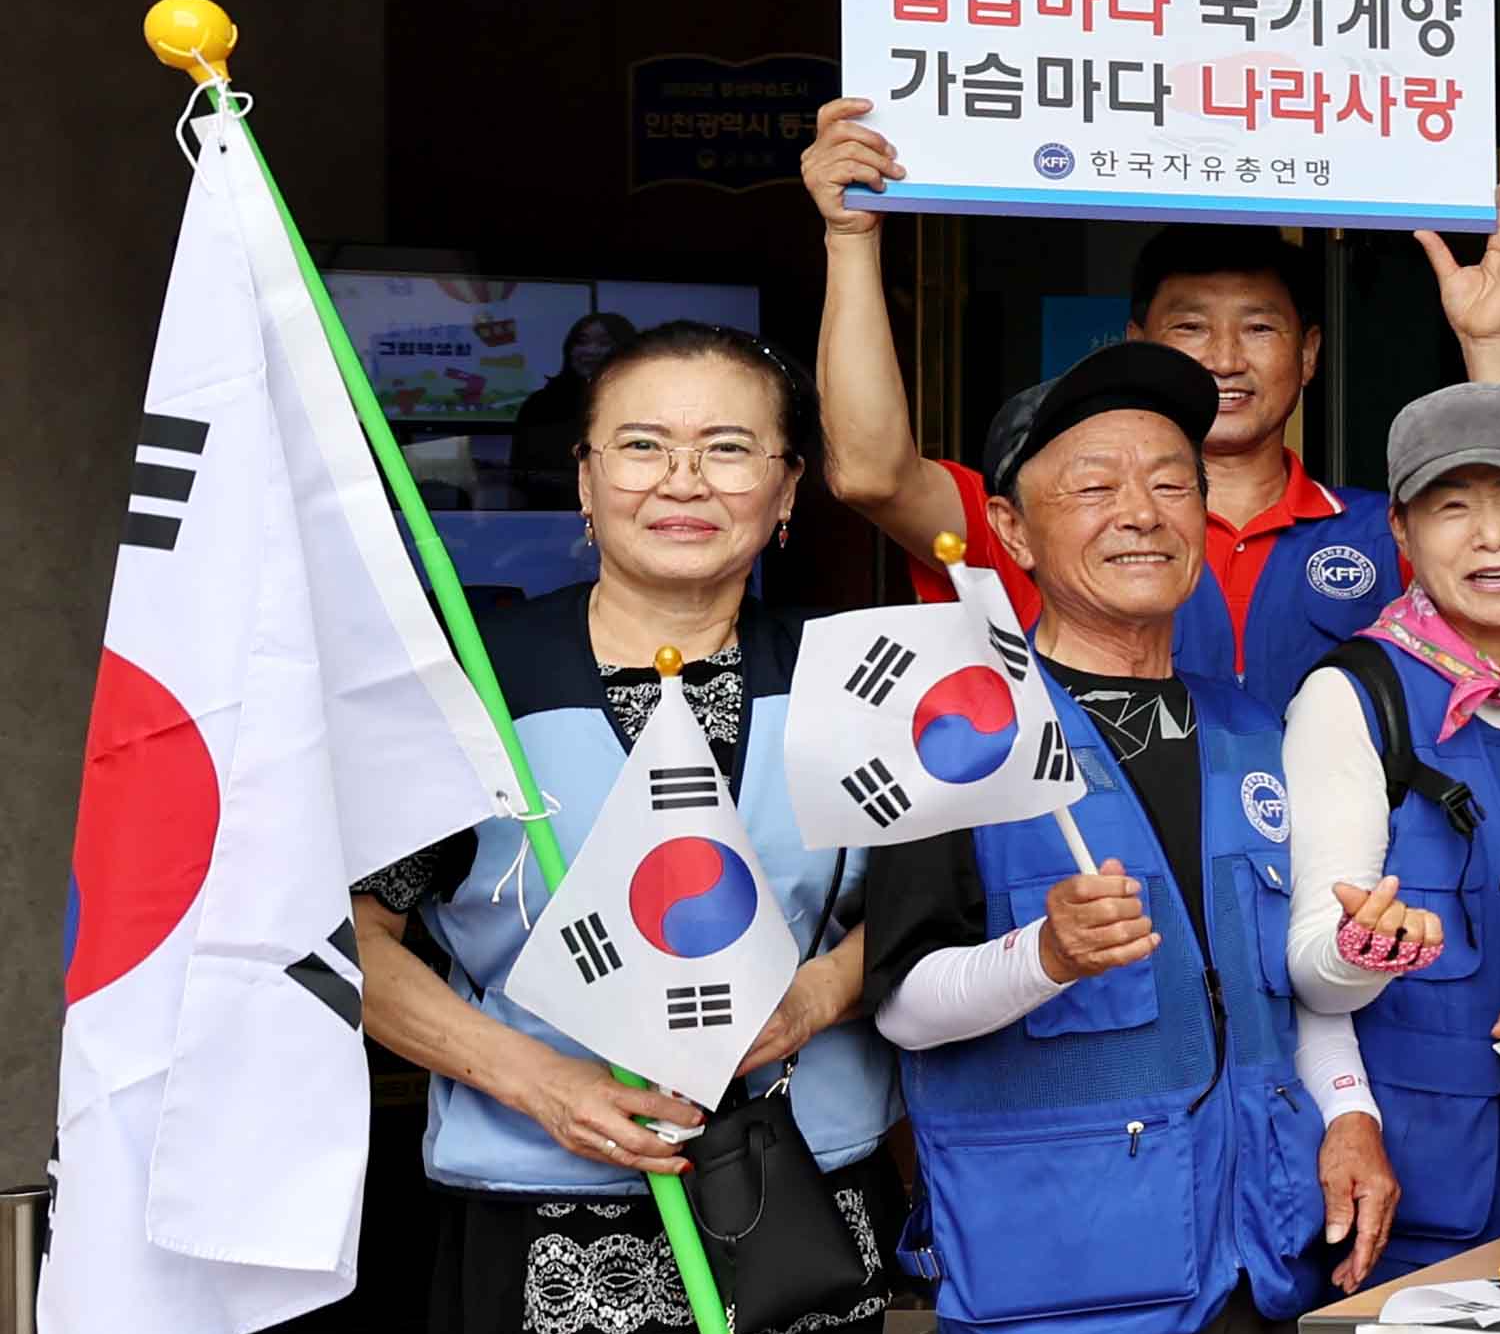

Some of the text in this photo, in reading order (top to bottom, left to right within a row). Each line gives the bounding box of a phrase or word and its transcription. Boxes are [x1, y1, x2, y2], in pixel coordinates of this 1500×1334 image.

[891, 49, 1462, 141] 가슴마다 나라사랑
[643, 111, 771, 140] 인천광역시
[1040, 154, 1069, 169] KFF
[1089, 149, 1332, 187] 한국자유총연맹
[1321, 566, 1361, 582] KFF
[1254, 799, 1282, 819] KFF
